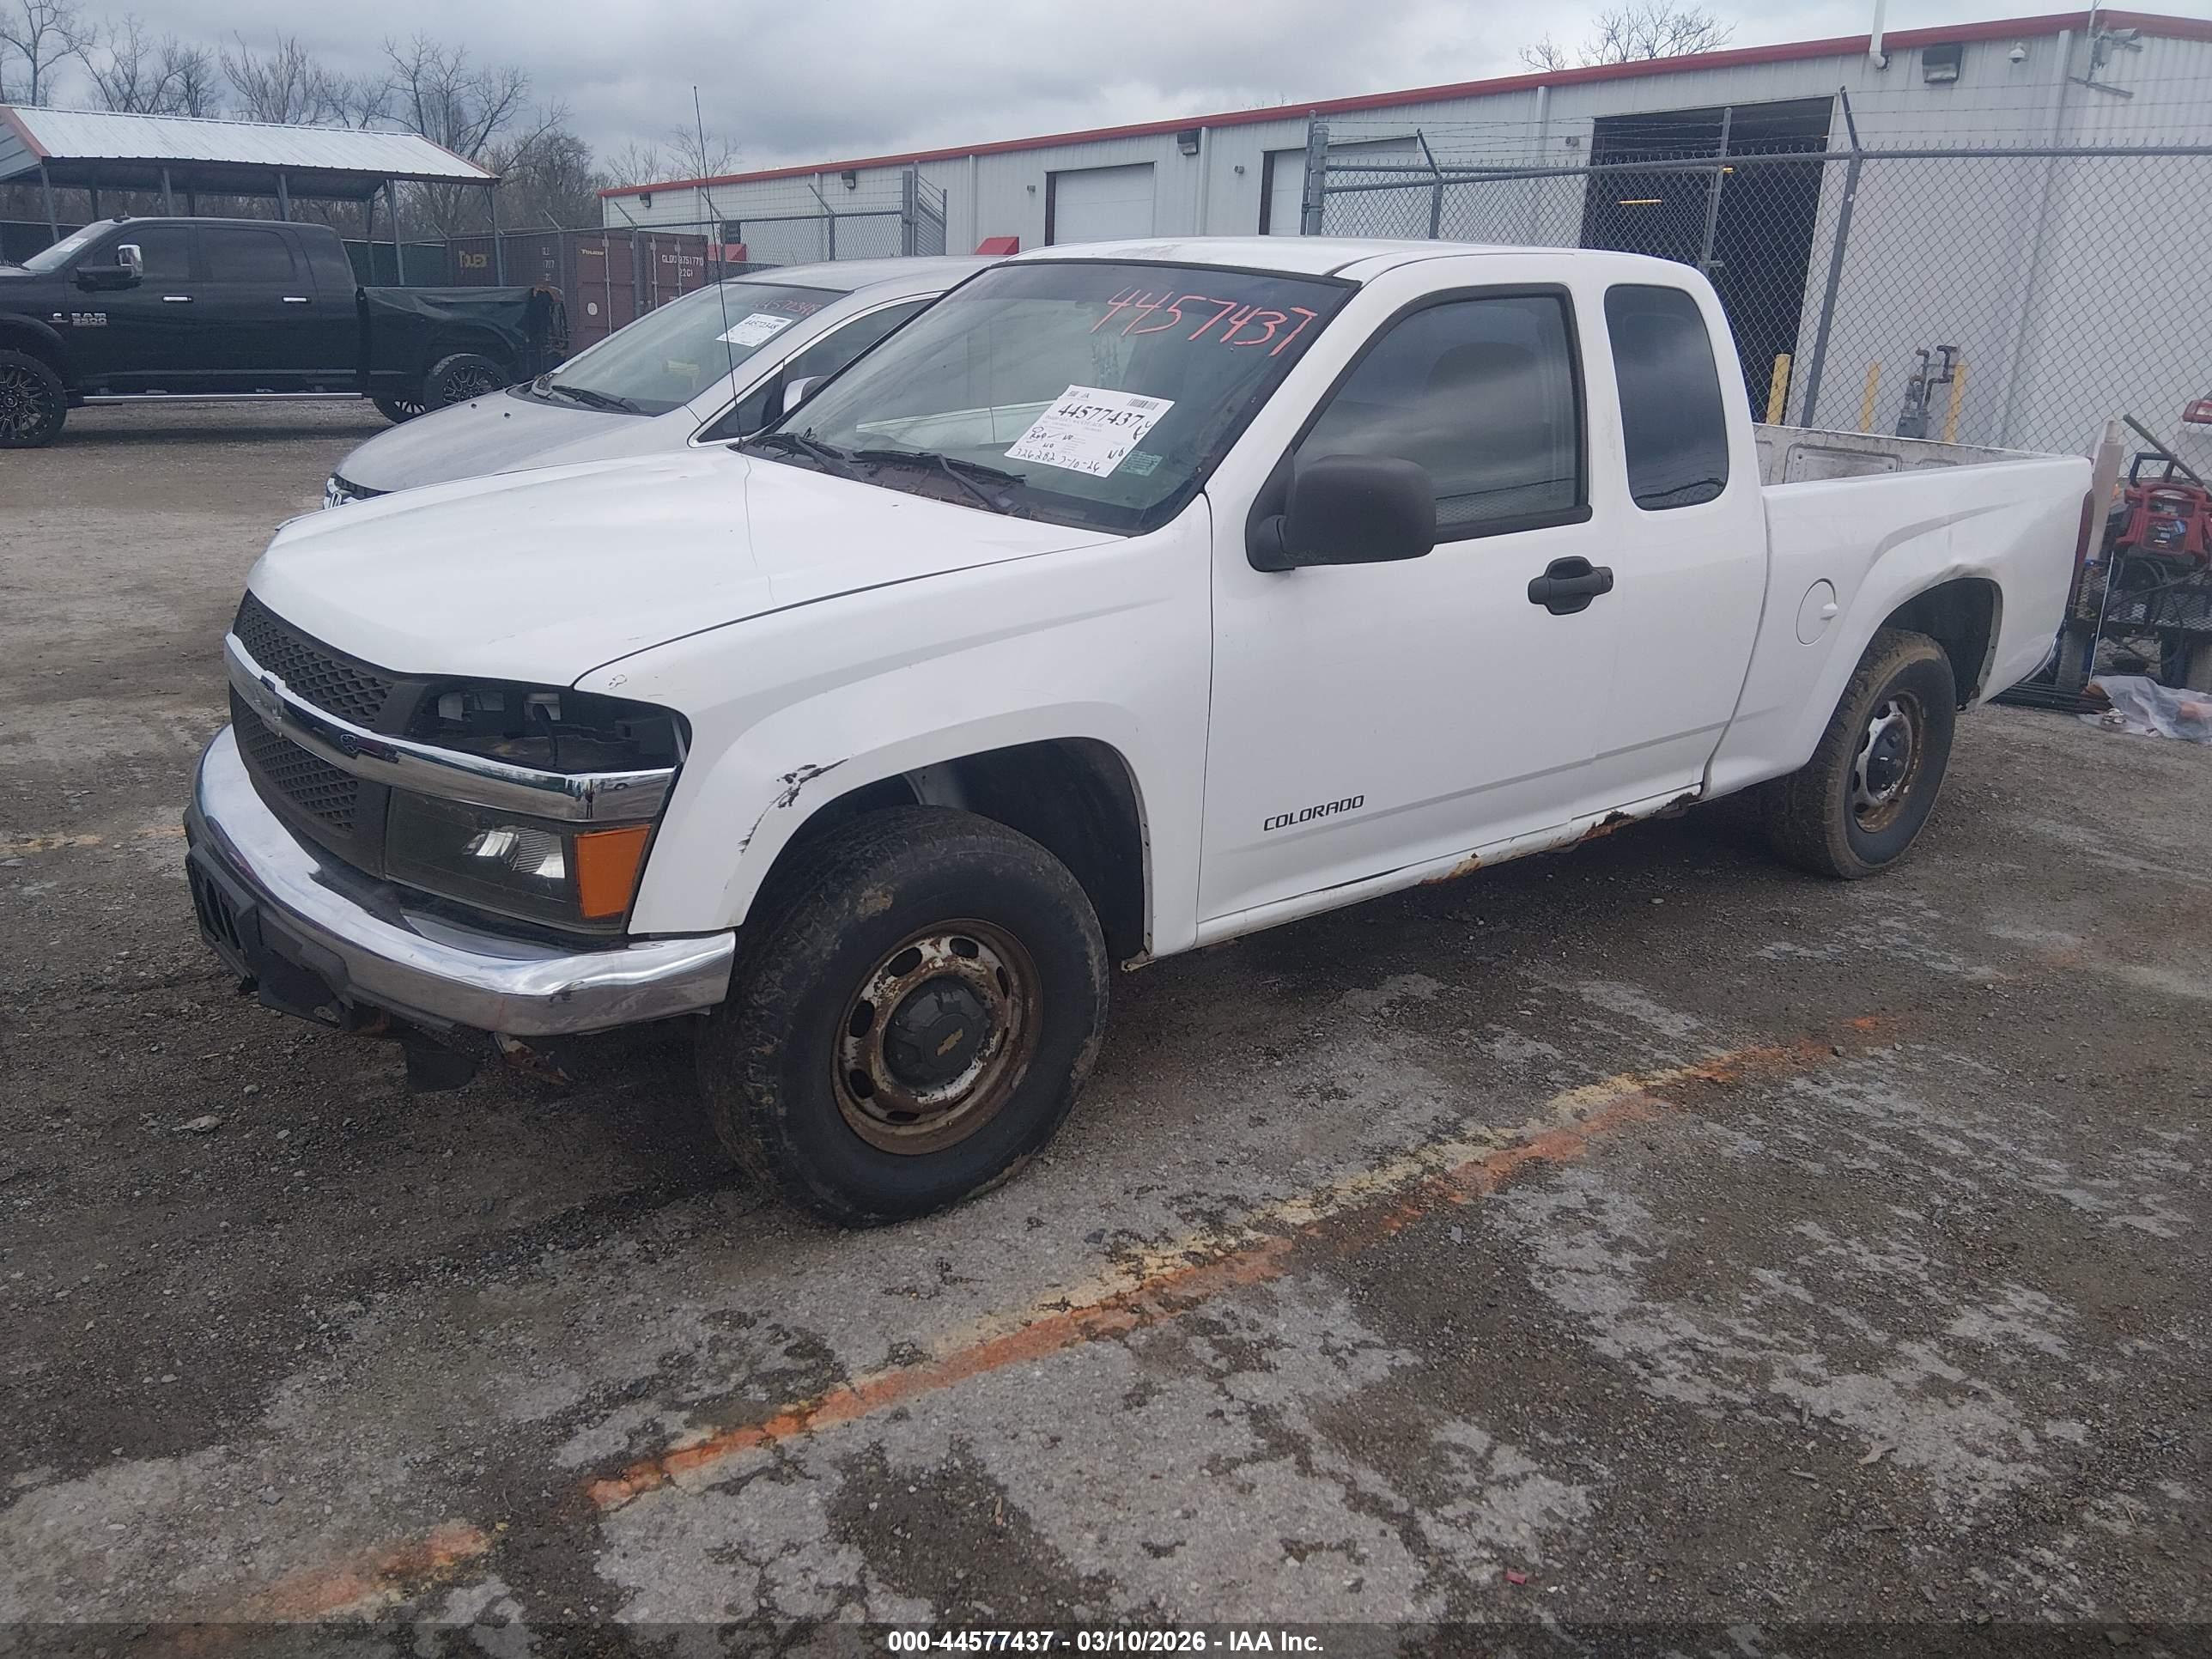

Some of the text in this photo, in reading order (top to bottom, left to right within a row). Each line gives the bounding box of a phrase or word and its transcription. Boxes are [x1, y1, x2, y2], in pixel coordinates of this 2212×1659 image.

[1090, 286, 1318, 357] 4457437
[1057, 403, 1146, 428] 44577437
[1263, 794, 1364, 831] COLORADO
